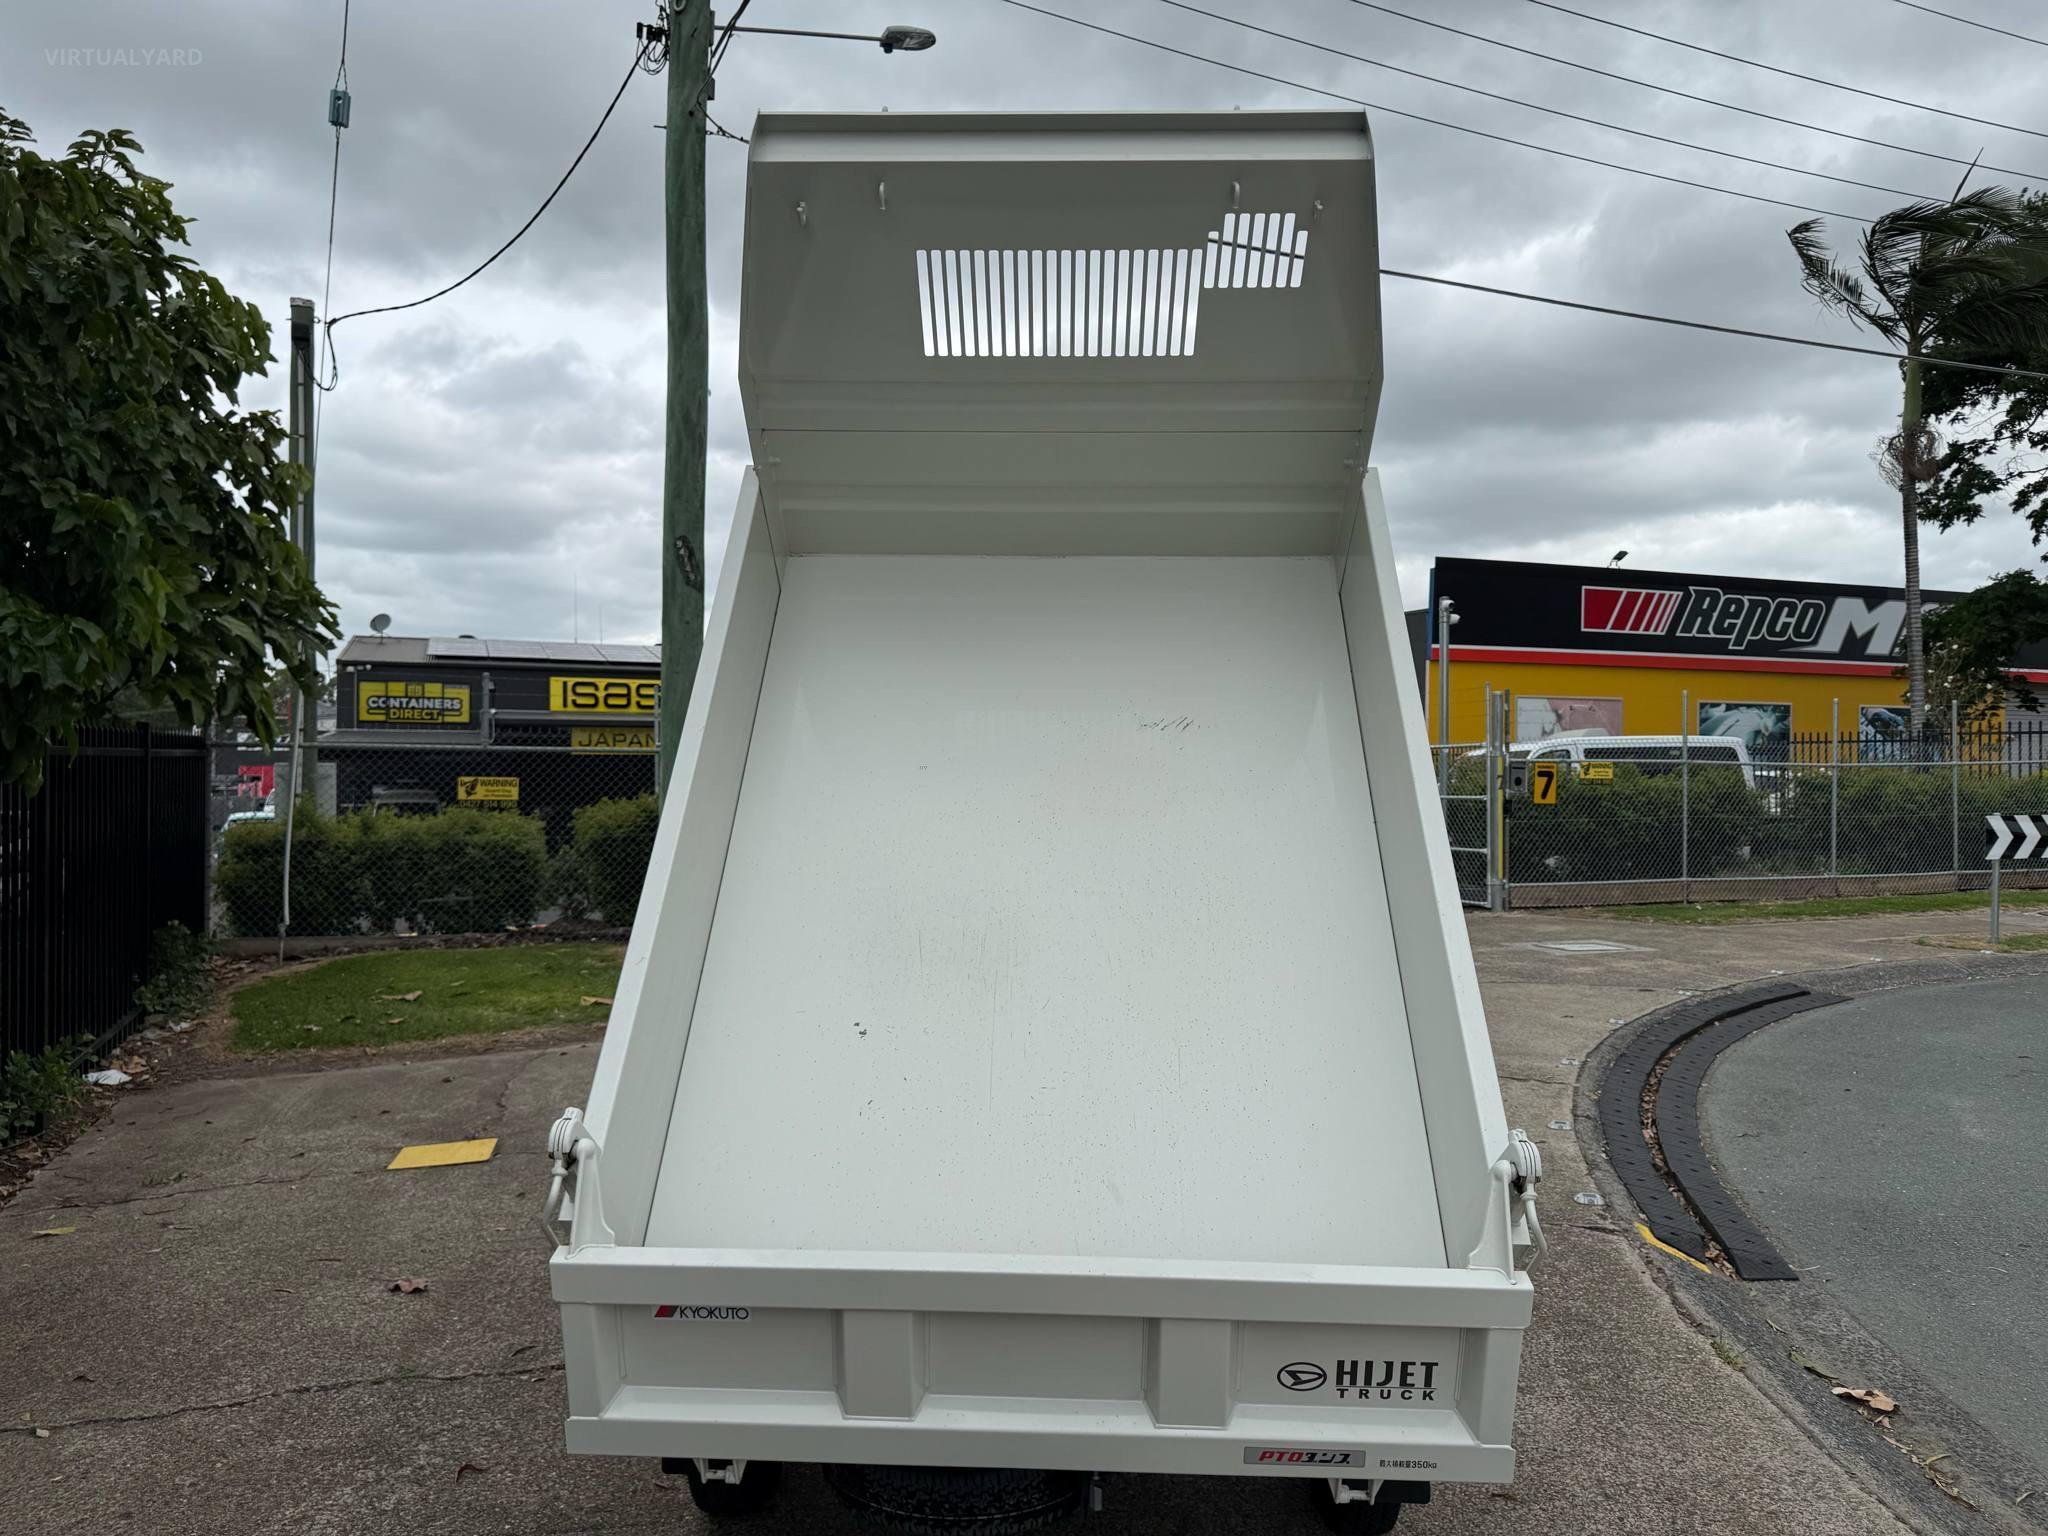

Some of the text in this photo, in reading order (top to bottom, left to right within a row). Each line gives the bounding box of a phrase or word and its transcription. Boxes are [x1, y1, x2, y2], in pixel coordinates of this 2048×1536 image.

[1676, 585, 1826, 650] Repco
[367, 696, 462, 709] CONTAINERS
[389, 708, 441, 719] DIRECT
[479, 778, 518, 788] WARNING
[1537, 770, 1554, 801] 7
[679, 1306, 749, 1320] KYOKUTO
[1336, 1359, 1439, 1389] HIJET
[1336, 1388, 1435, 1401] TRUCK
